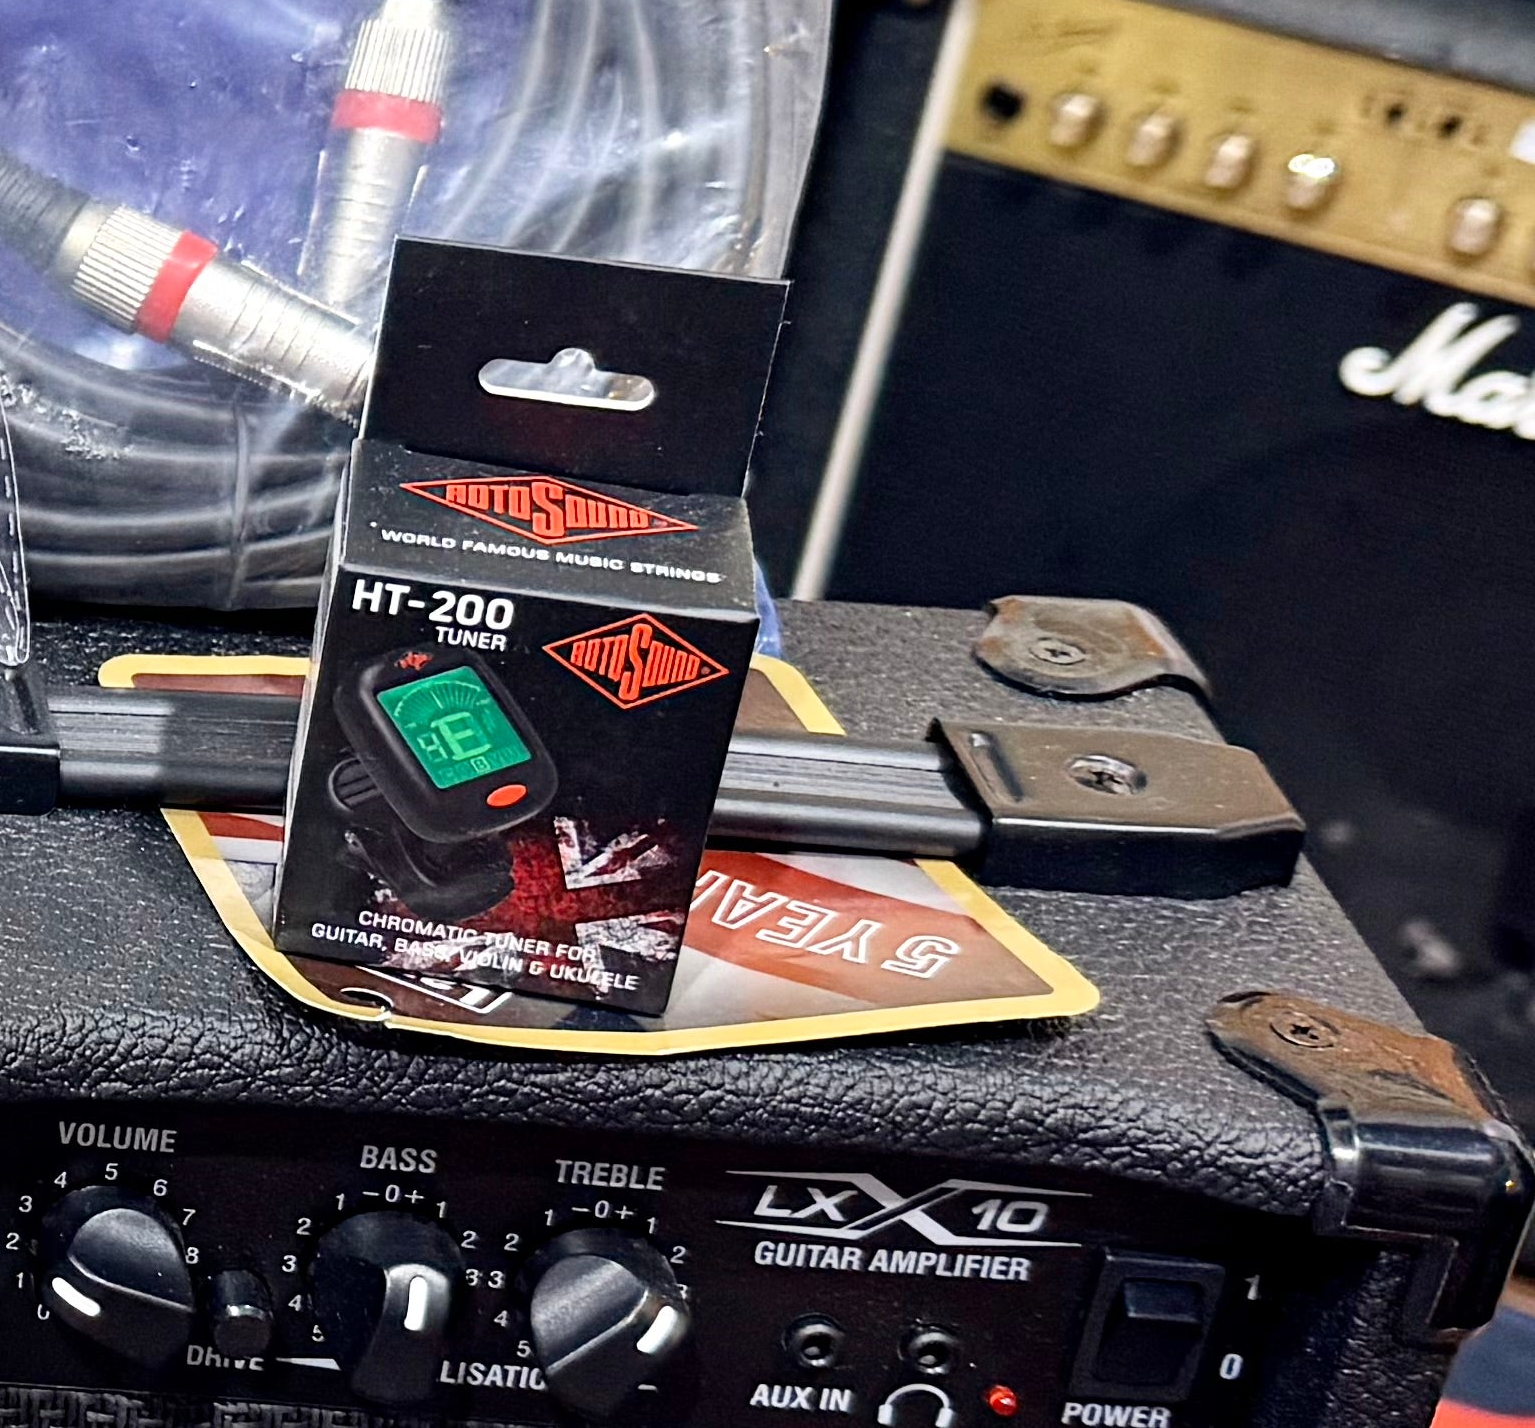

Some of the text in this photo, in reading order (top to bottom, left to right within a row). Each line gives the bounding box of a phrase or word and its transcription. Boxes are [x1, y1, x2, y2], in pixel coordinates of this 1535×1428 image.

[1338, 301, 1535, 440] Ma
[380, 528, 722, 585] WORLD FAMOUS MUSIC STRINGS
[352, 579, 515, 631] HT-200
[435, 626, 508, 652] TUNER
[359, 910, 597, 962] CHROMATIC TUNER FOR
[311, 922, 387, 951] GUITAR,
[459, 951, 524, 975] VIOLIN
[550, 963, 640, 992] UKULELE
[881, 933, 961, 979] 5
[58, 1120, 179, 1154] VOLUME
[360, 1143, 439, 1174] BASS
[53, 1171, 69, 1188] 4
[104, 1163, 119, 1181] 5
[555, 1158, 667, 1192] TREBLE
[152, 1179, 168, 1197] 6
[18, 1196, 33, 1213] 3
[335, 1192, 346, 1212] 1
[436, 1200, 448, 1219] 1
[182, 1208, 197, 1226] 7
[296, 1217, 312, 1236] 2
[544, 1208, 555, 1227] 1
[647, 1216, 658, 1234] 1
[5, 1233, 20, 1250] 2
[461, 1230, 478, 1249] 2
[503, 1233, 521, 1252] 2
[184, 1246, 200, 1264] 8
[280, 1255, 297, 1273] 3
[671, 1245, 688, 1264] 2
[754, 1240, 1031, 1282] GUITAR AMPLIFIER
[15, 1272, 26, 1289] 1
[487, 1270, 504, 1289] 3
[287, 1293, 303, 1312] 4
[493, 1309, 510, 1327] 4
[516, 1339, 532, 1358] 5
[435, 1358, 548, 1392] LISATIO
[1219, 1353, 1243, 1380] 0
[750, 1383, 851, 1413] AUX IN
